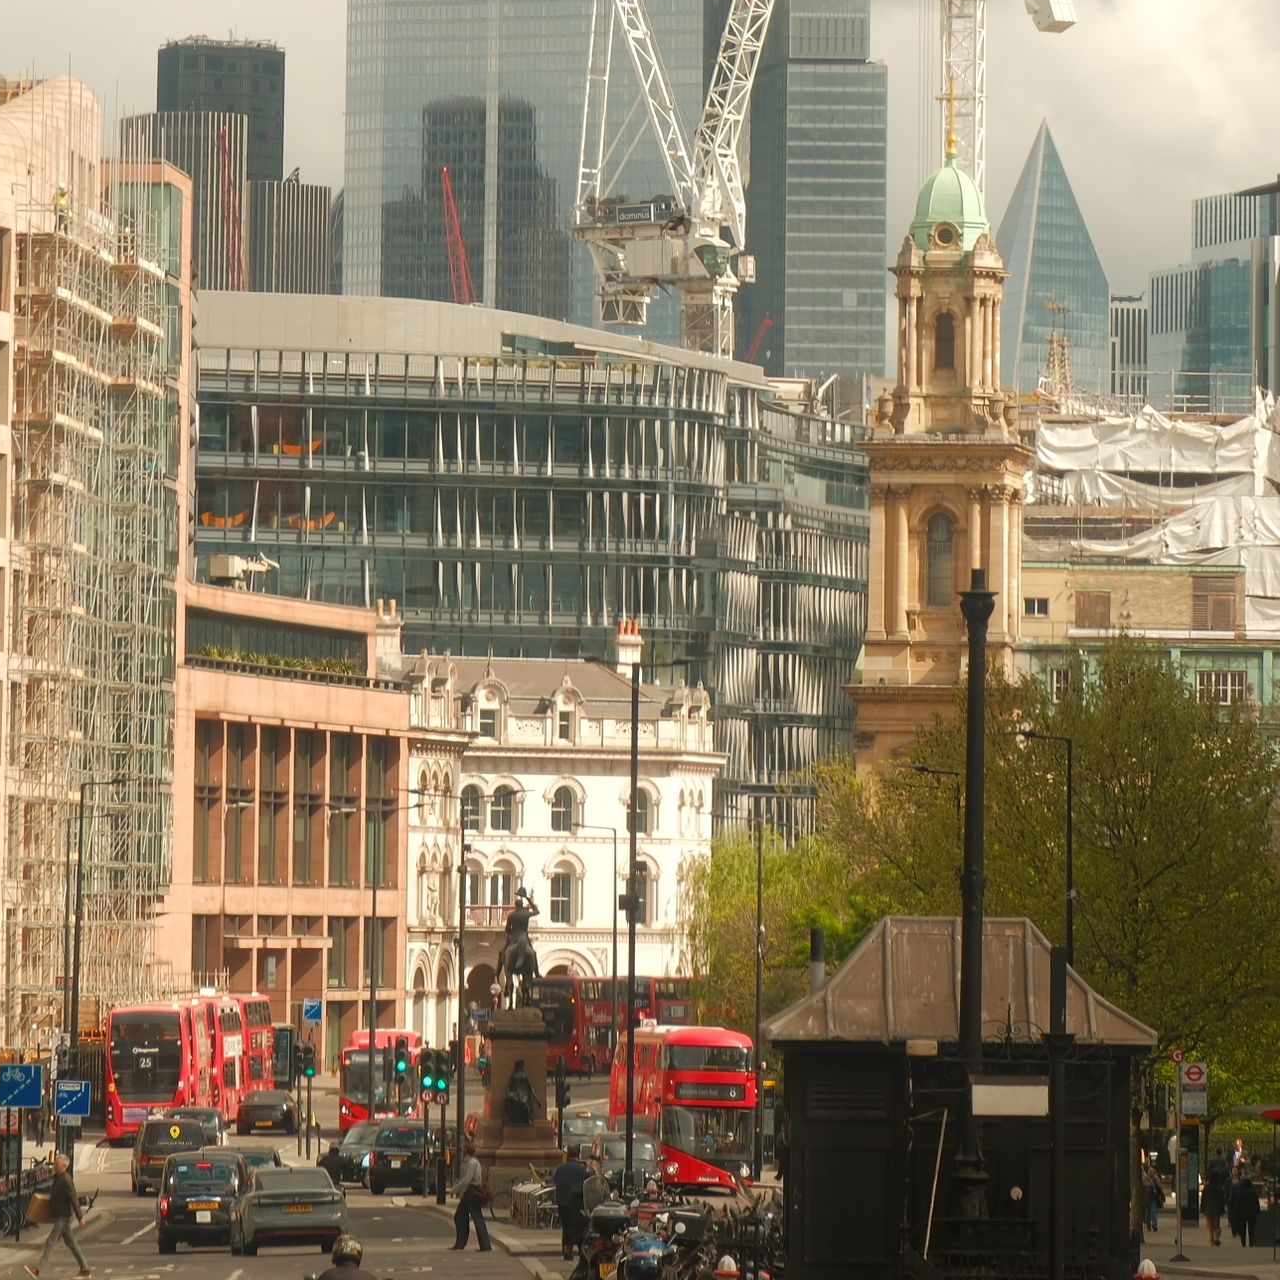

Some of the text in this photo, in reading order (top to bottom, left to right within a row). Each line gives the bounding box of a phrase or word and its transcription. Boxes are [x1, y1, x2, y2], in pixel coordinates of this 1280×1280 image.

[619, 212, 650, 221] dominus
[1174, 1051, 1182, 1061] G
[140, 1058, 152, 1068] 25
